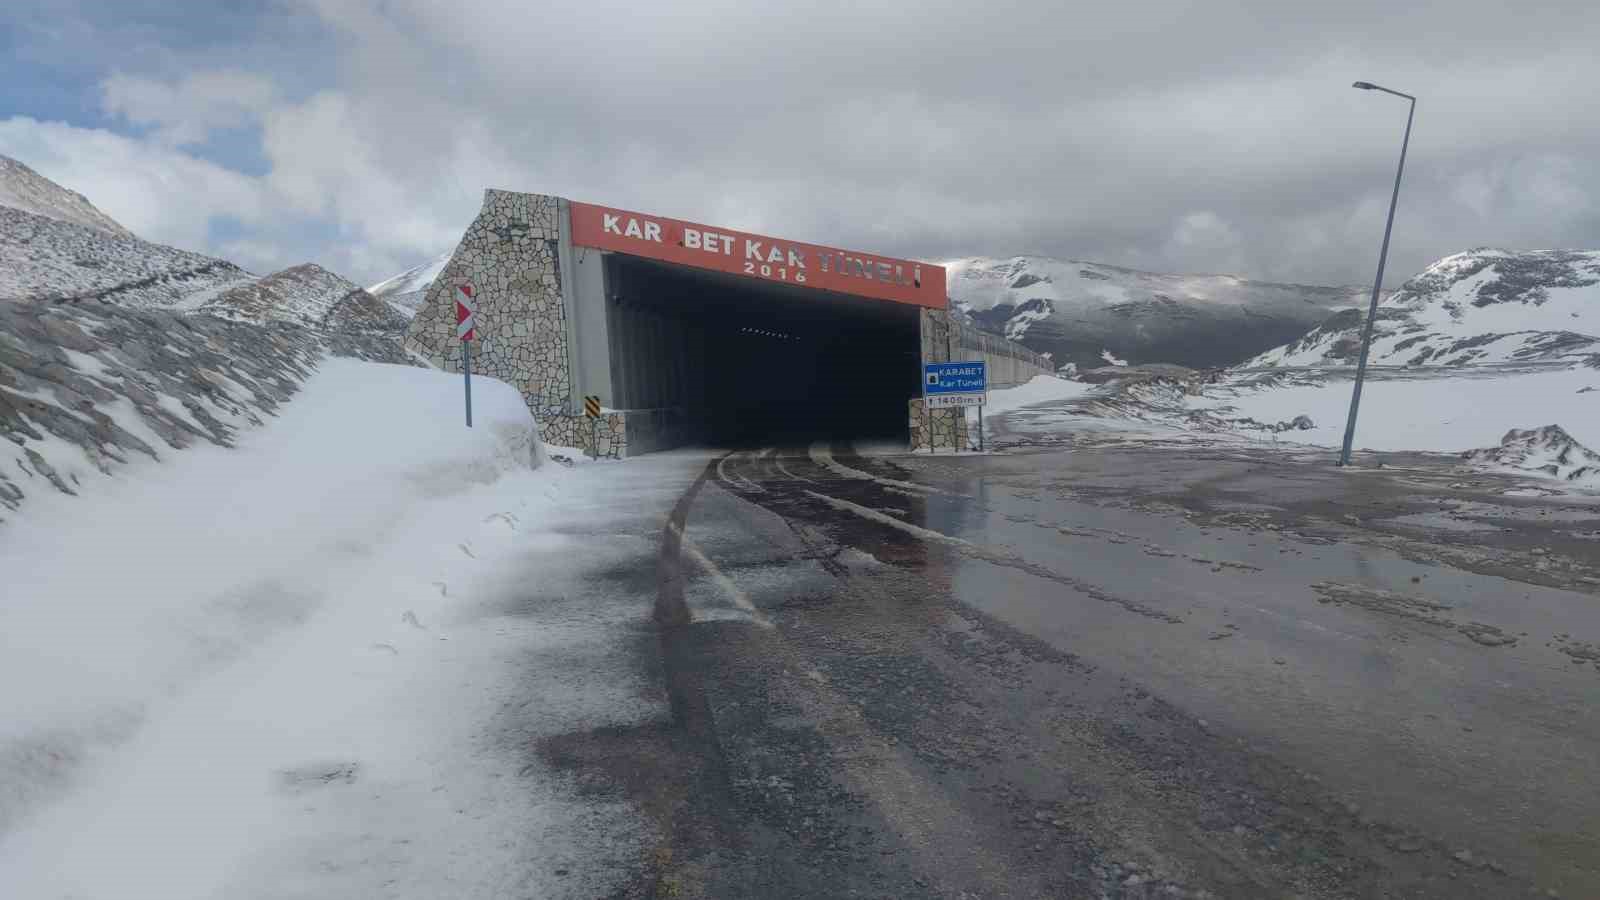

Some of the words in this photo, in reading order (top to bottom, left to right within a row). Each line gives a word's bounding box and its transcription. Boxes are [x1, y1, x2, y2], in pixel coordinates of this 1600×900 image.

[745, 239, 806, 268] KAR
[743, 261, 806, 282] 2016
[939, 367, 983, 376] KARABET
[939, 380, 957, 388] Kar
